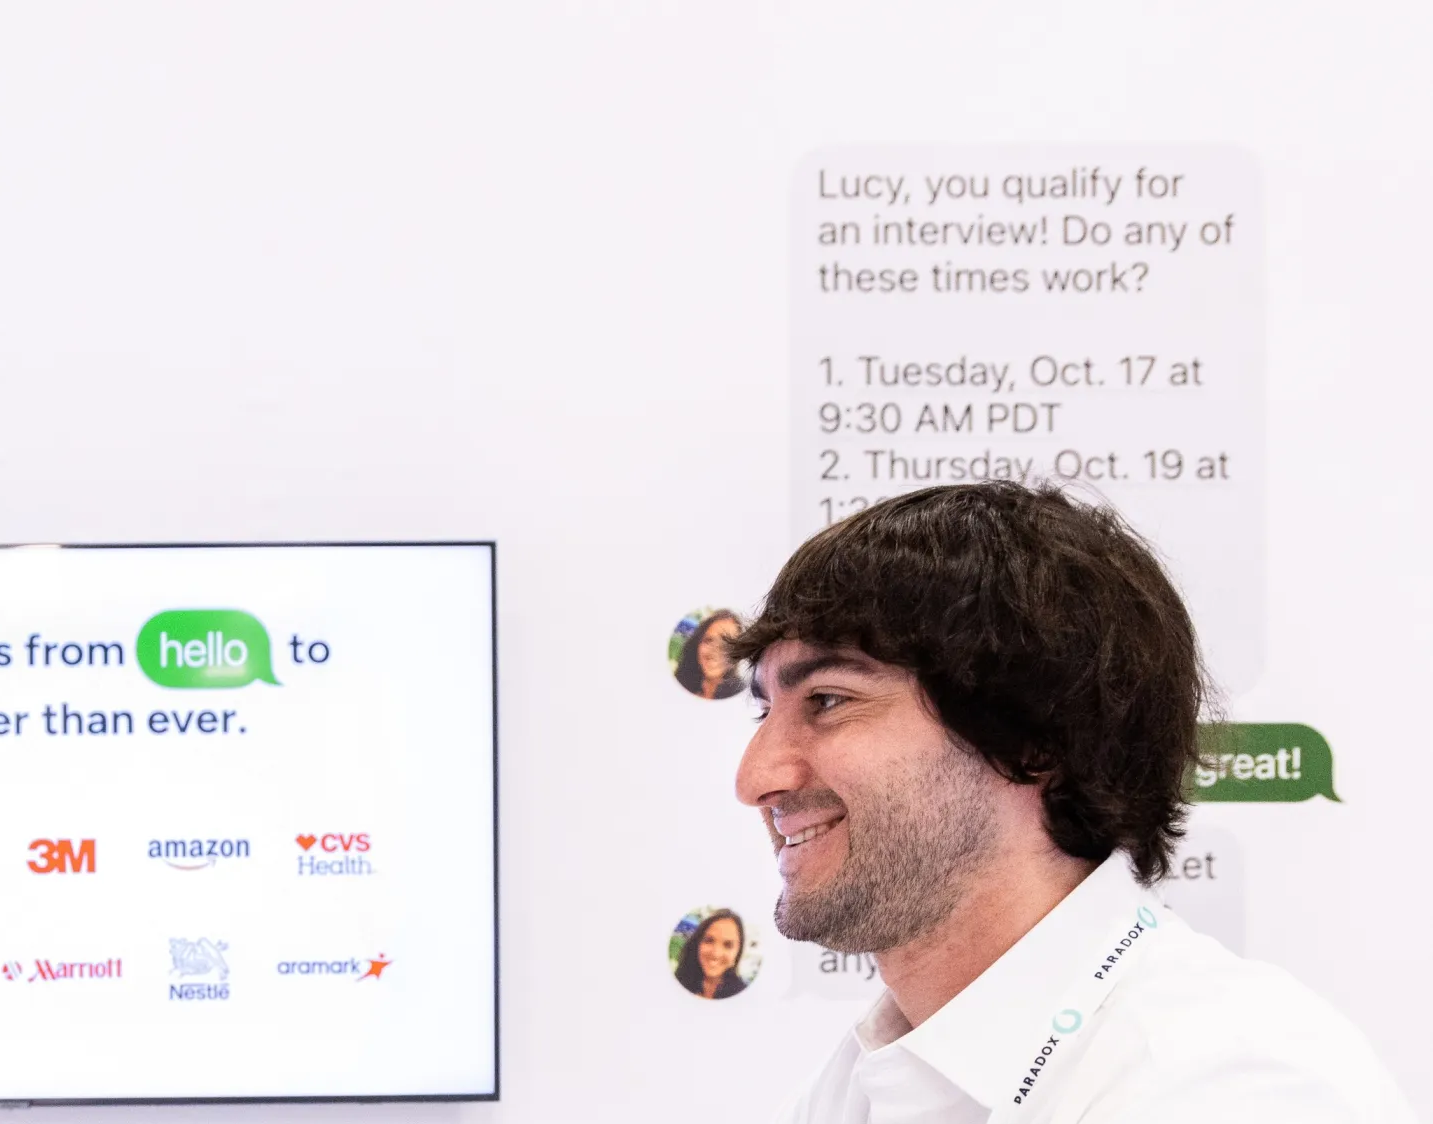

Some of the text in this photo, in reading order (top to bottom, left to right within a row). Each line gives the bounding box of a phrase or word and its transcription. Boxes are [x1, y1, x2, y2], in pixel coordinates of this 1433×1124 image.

[819, 167, 1183, 206] Lucy, you qualify for
[818, 214, 1233, 252] an interview! Do any of
[819, 262, 1149, 292] these times work?
[820, 355, 1201, 393] 1. Tuesday, Oct. 17 at
[819, 402, 1061, 434] 9:30 AM PDT
[820, 449, 849, 480] 2.
[1054, 450, 1128, 485] Oct.
[1144, 449, 1183, 480] 19
[1196, 453, 1228, 479] at
[26, 634, 123, 665] from
[160, 631, 248, 668] hello
[290, 635, 329, 663] to
[43, 704, 133, 735] than
[148, 711, 245, 734] ever.
[1195, 747, 1301, 787] great!
[27, 839, 97, 873] 3M
[148, 838, 250, 858] amazon
[321, 833, 371, 853] CVS
[297, 855, 372, 875] Health
[277, 959, 360, 976] aramark
[1094, 922, 1145, 980] PARADOX
[28, 958, 122, 982] Marriott
[1014, 1035, 1060, 1105] PARADOX
